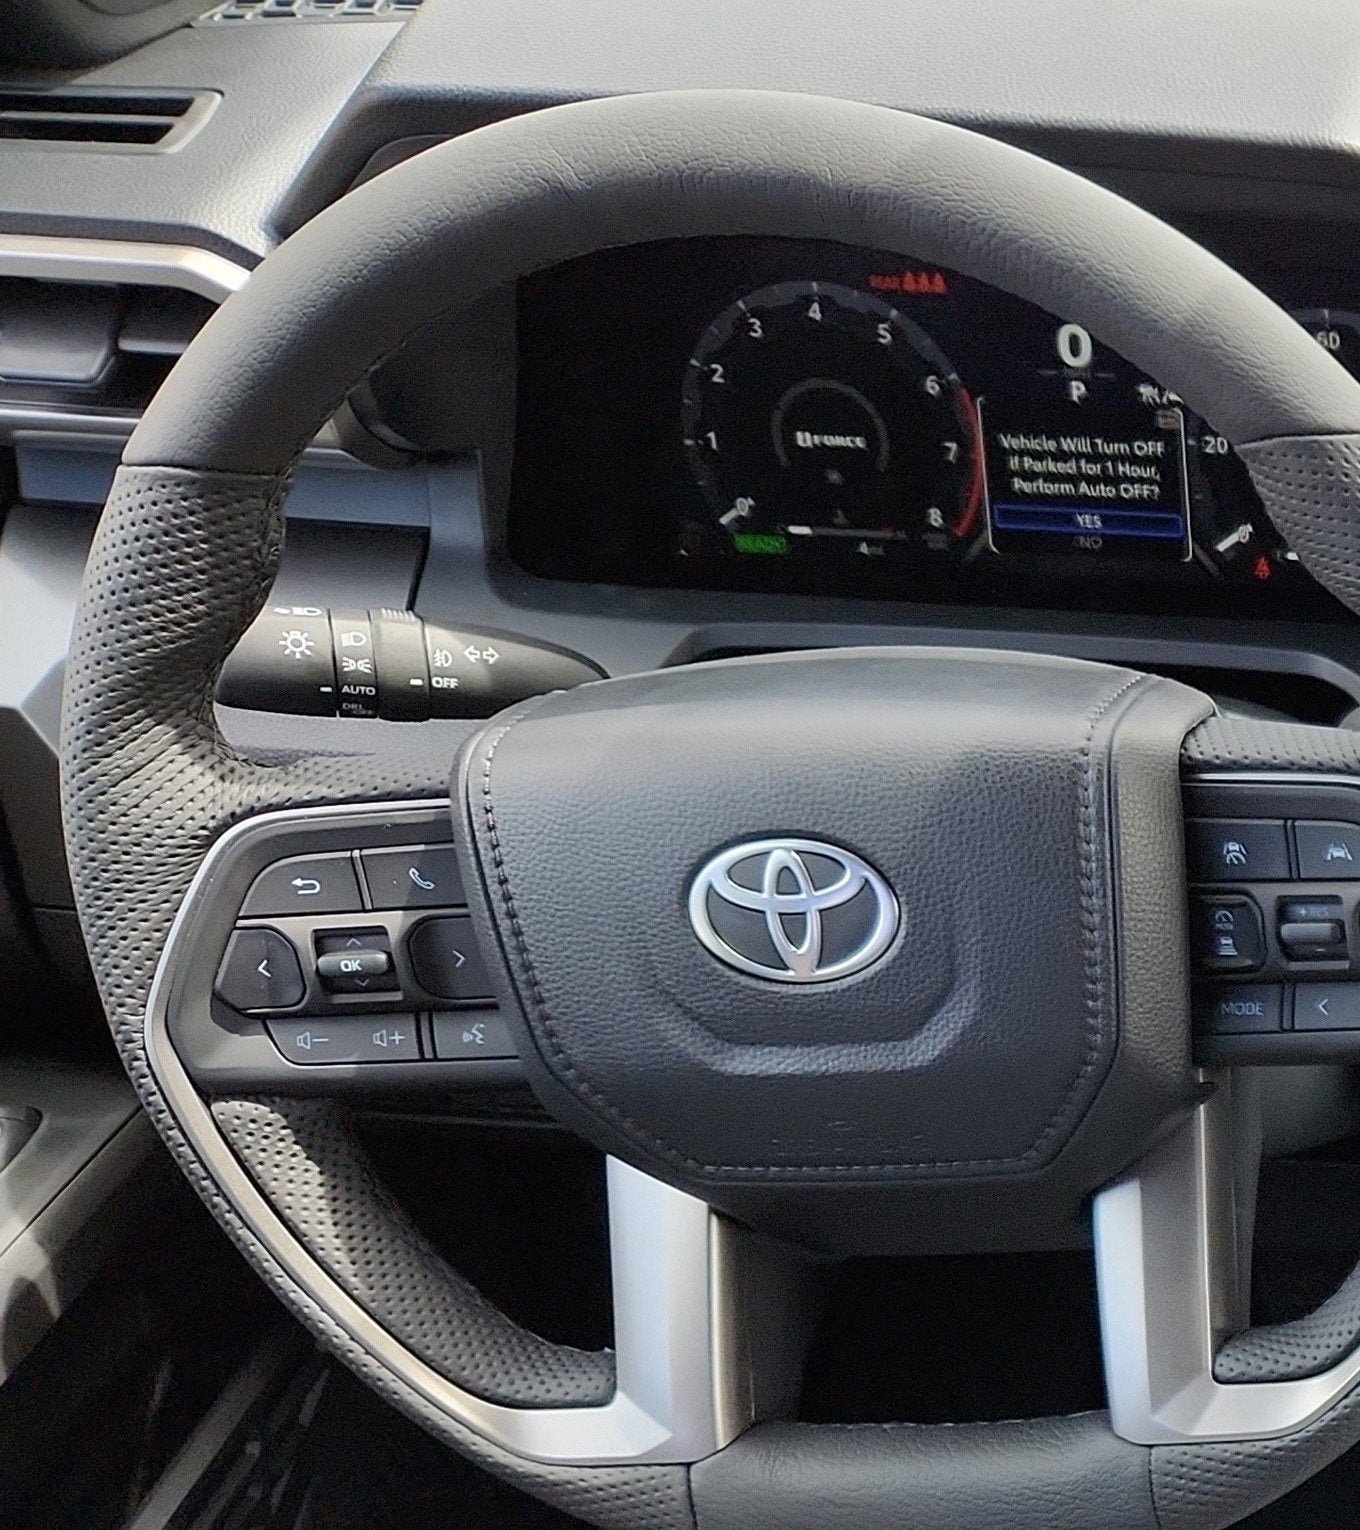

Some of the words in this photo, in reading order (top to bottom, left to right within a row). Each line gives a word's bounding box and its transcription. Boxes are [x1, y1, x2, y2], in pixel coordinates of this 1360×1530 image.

[808, 302, 822, 322] 4
[749, 317, 763, 339] 3
[877, 323, 893, 345] 5
[1056, 323, 1093, 368] 0
[710, 363, 725, 384] 2
[925, 374, 942, 397] 6
[706, 430, 718, 450] 1
[1000, 432, 1058, 453] Vehicle
[1060, 435, 1092, 455] Will
[1096, 437, 1130, 456] Turn
[1134, 440, 1165, 459] OFF
[1203, 435, 1229, 456] 20
[941, 440, 958, 463] 7
[1023, 455, 1077, 476] Parked
[1081, 457, 1102, 476] for
[1118, 462, 1161, 482] Hour,
[1011, 476, 1075, 496] Perform
[1079, 480, 1116, 499] Auto
[1120, 483, 1161, 501] OFF?
[927, 506, 944, 528] 8
[1075, 512, 1103, 529] YES
[341, 684, 377, 697] AUTO
[431, 676, 460, 690] OFF
[340, 959, 364, 972] OK
[1220, 1001, 1265, 1016] MODE
